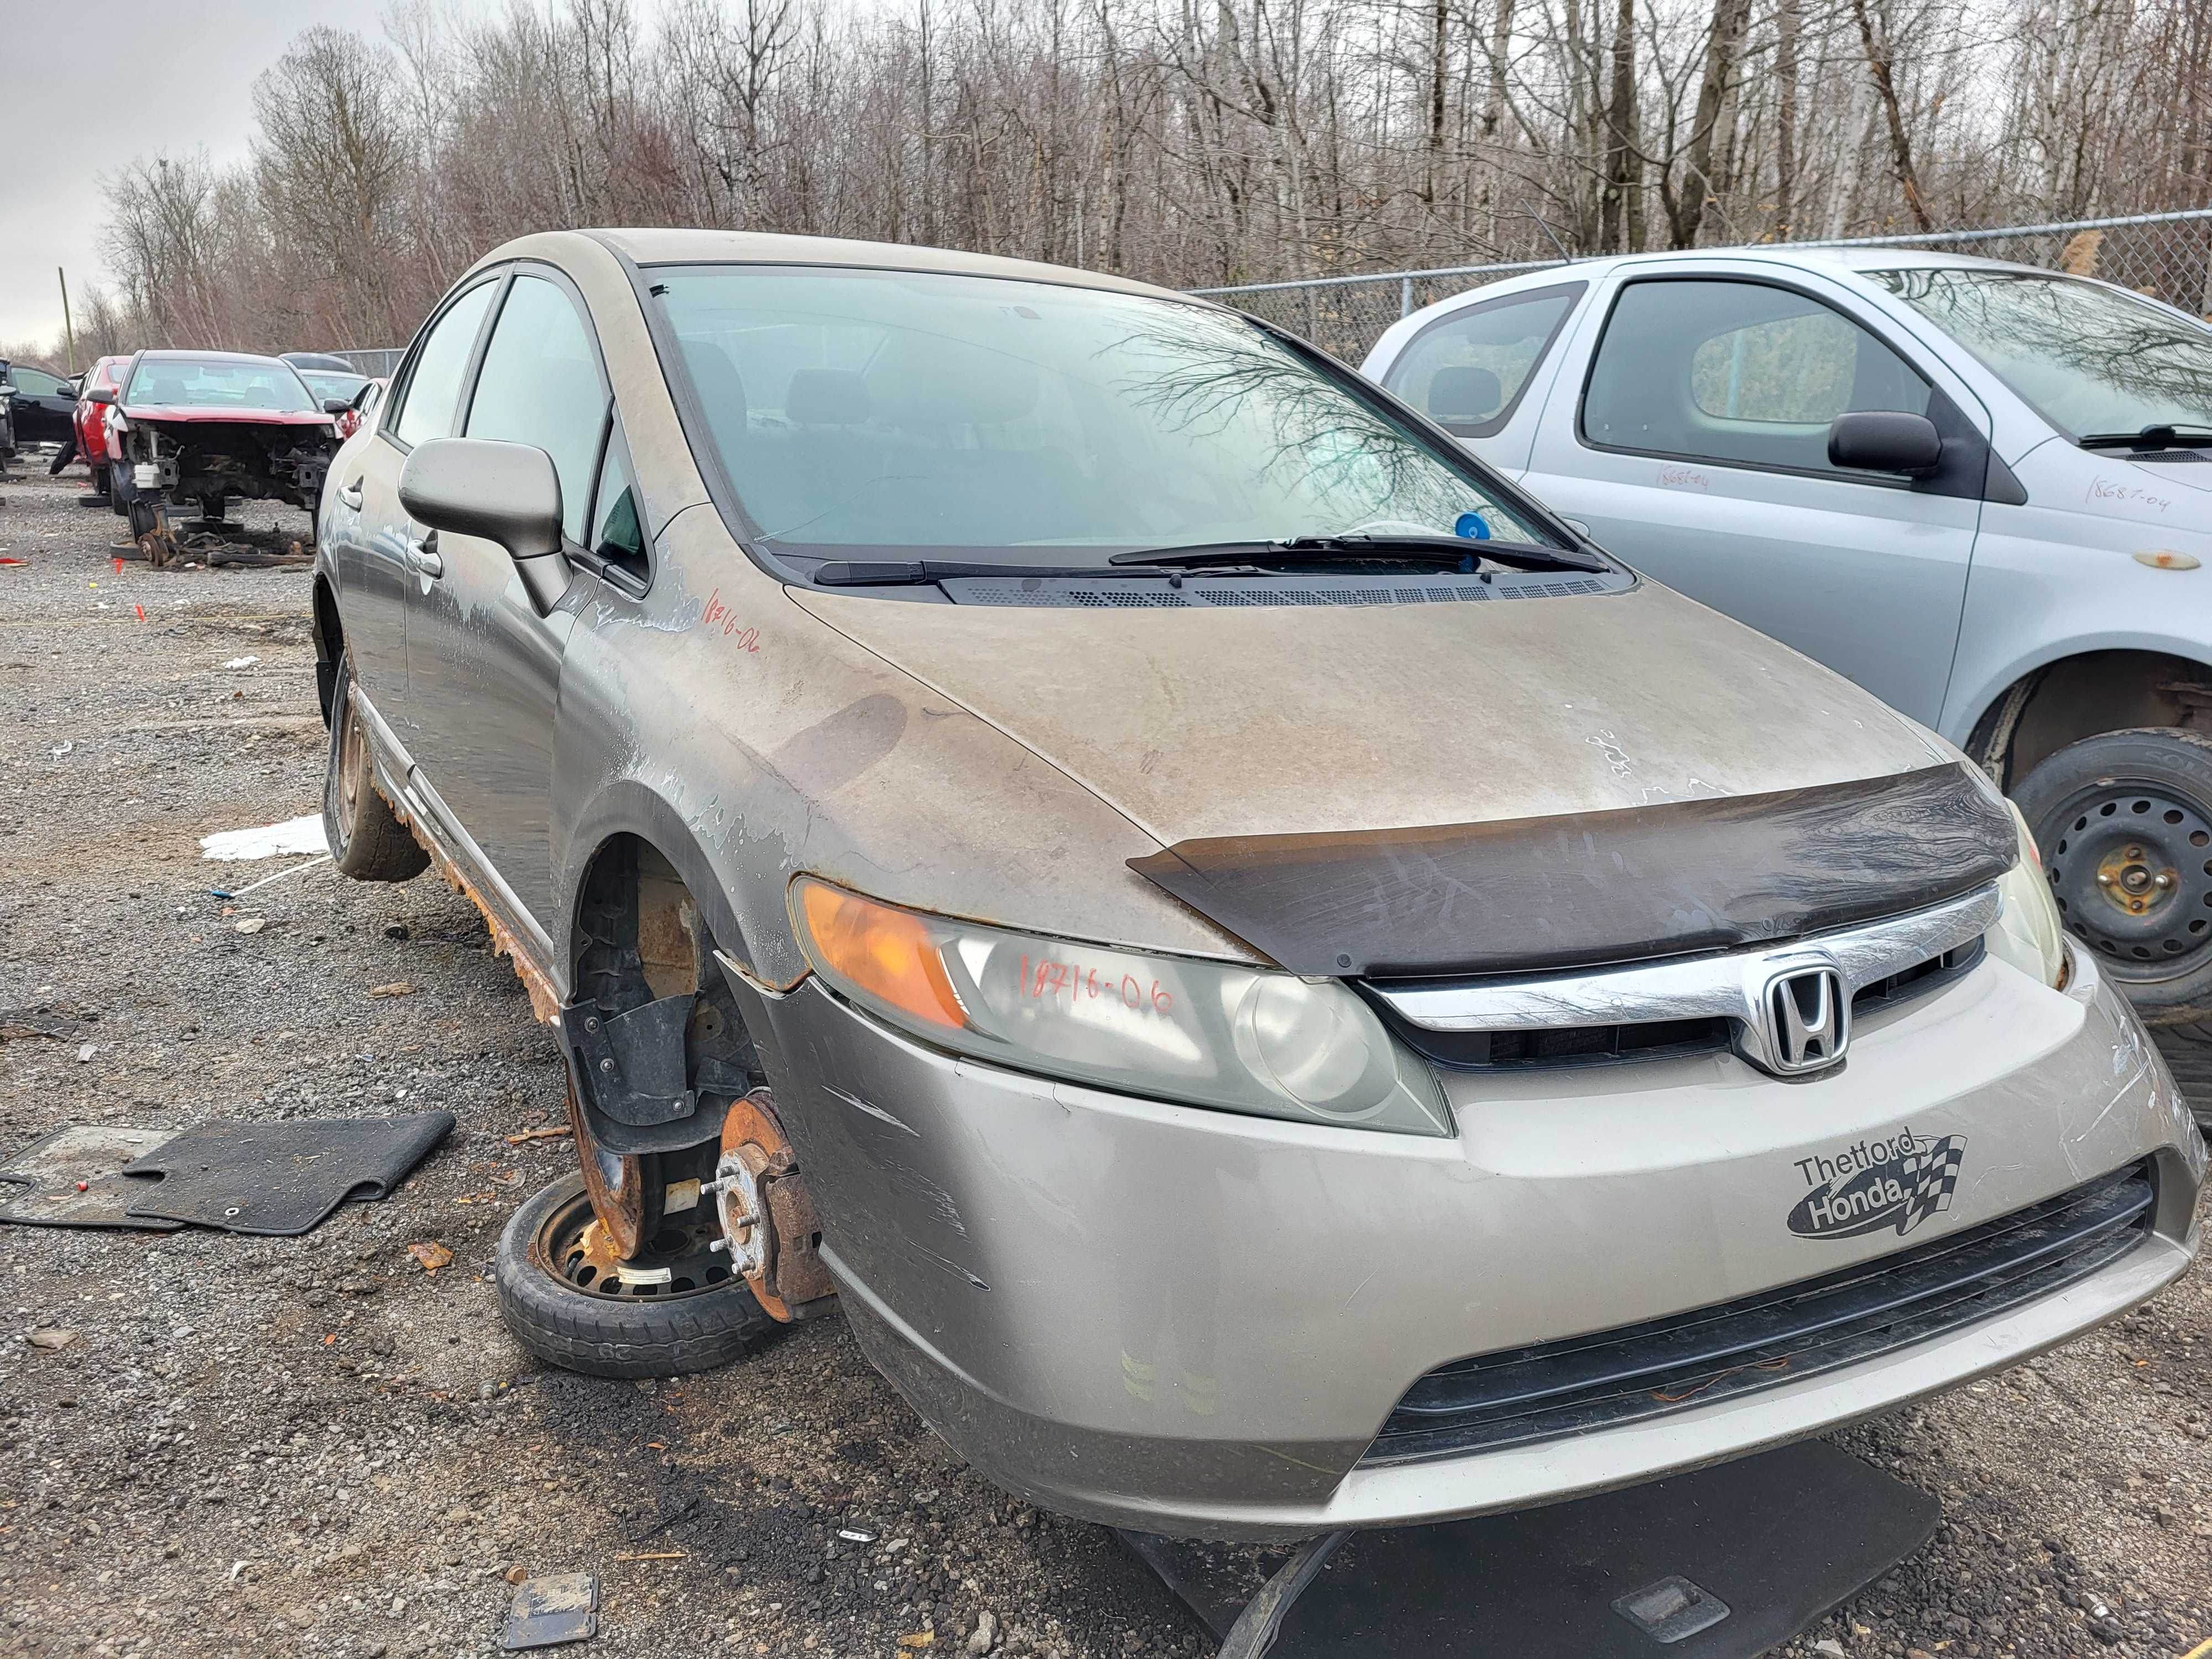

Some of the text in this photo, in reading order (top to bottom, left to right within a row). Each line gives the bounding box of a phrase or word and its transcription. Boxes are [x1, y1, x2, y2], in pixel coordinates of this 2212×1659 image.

[1020, 955, 1173, 1013] 18716-06
[1793, 1126, 1916, 1186] Thetford
[1808, 1177, 1903, 1229] Honda
